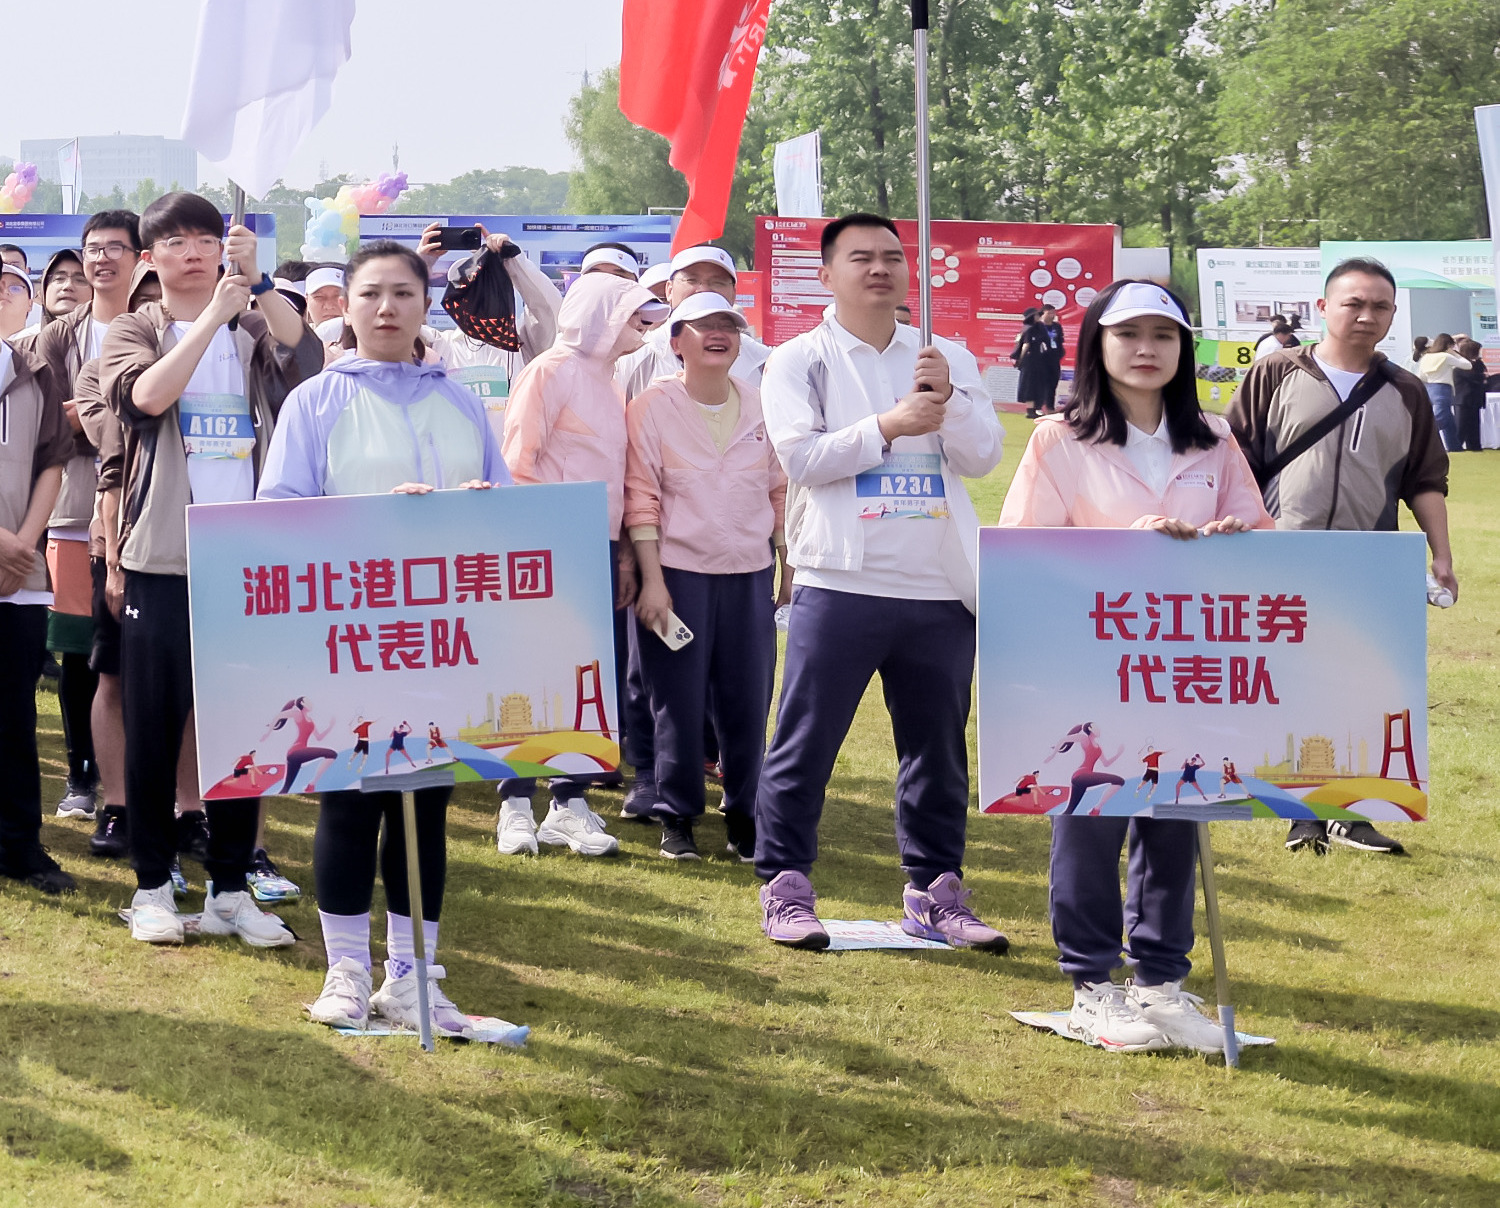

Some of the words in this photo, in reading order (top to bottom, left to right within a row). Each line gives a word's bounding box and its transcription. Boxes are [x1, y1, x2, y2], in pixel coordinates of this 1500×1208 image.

[772, 233, 784, 241] 01
[978, 237, 993, 245] 05
[771, 305, 784, 313] 02
[1237, 347, 1252, 364] 8
[189, 415, 238, 436] A162
[880, 475, 932, 495] A234
[242, 549, 554, 616] 湖北港口集团
[1088, 591, 1308, 643] 长江证券
[325, 617, 479, 674] 代表队
[1116, 654, 1280, 705] 代表队
